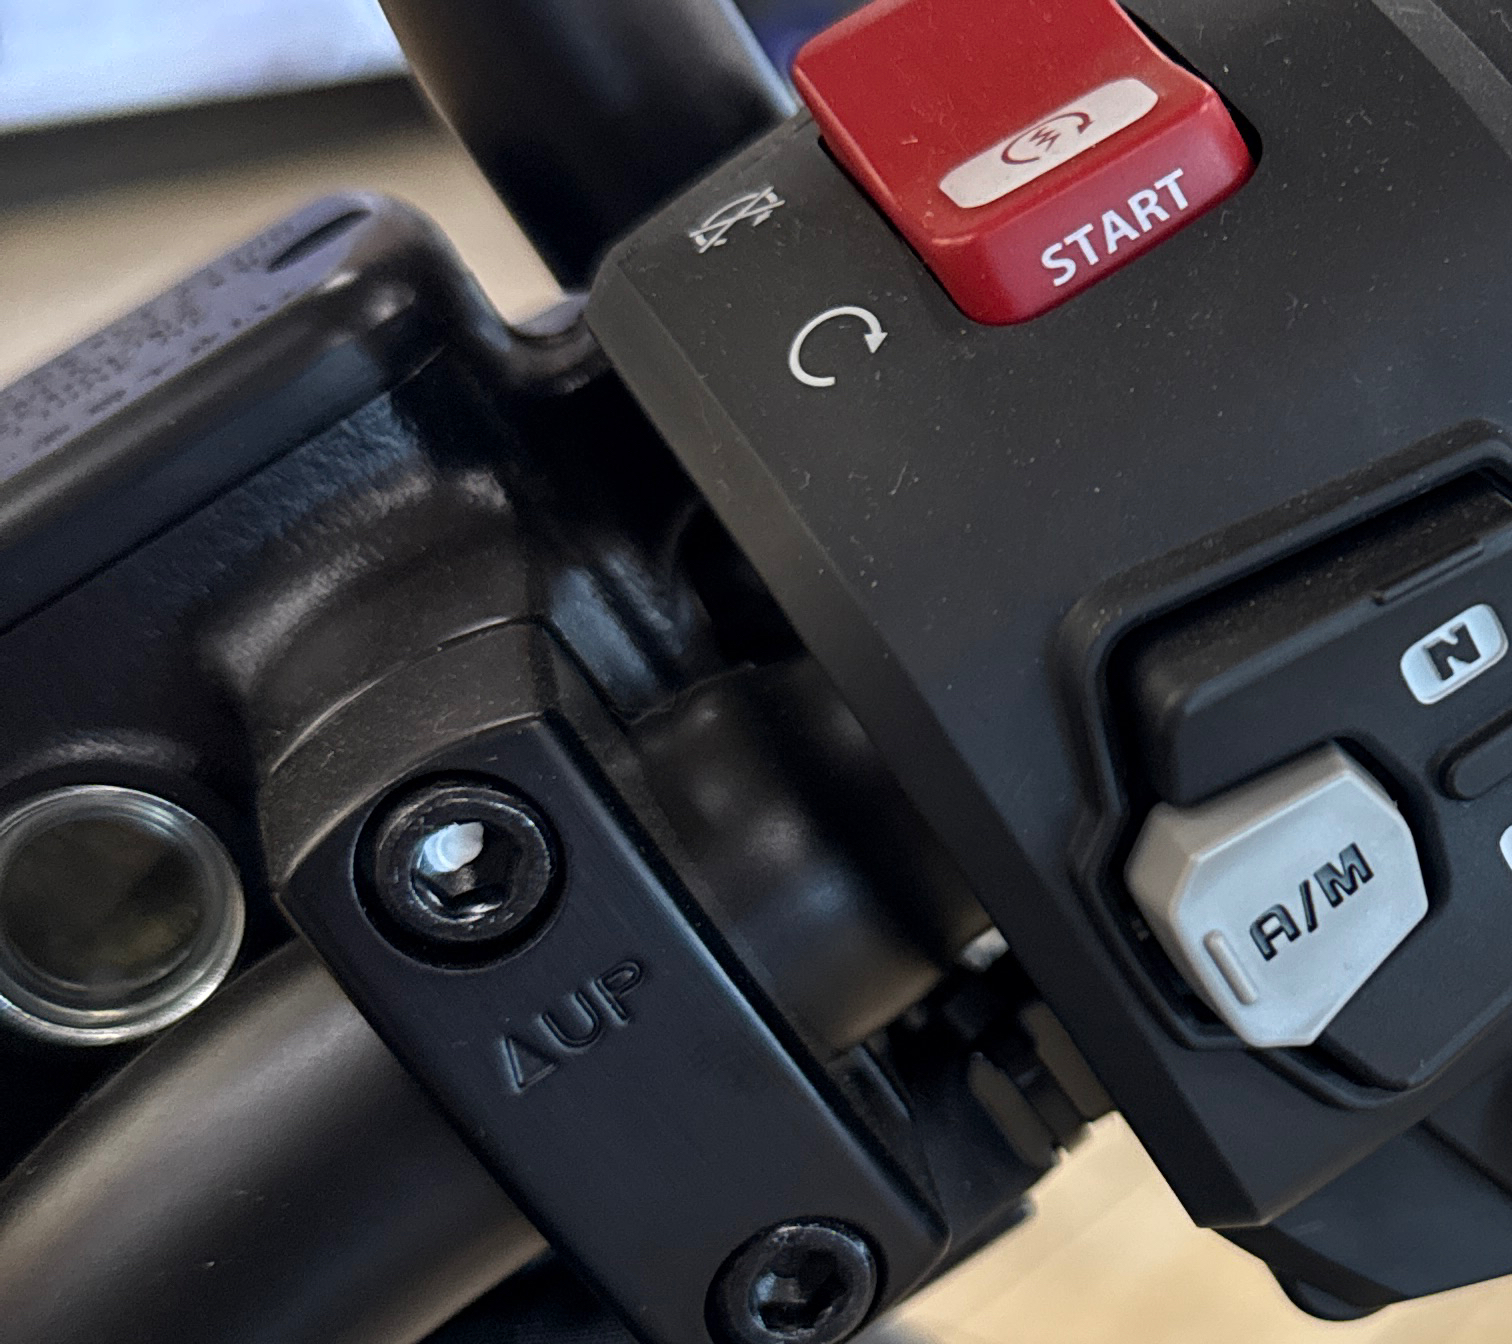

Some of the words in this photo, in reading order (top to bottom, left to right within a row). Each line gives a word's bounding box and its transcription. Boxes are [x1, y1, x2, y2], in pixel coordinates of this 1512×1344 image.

[1041, 167, 1189, 287] START
[1423, 622, 1482, 682] N
[1247, 841, 1377, 963] A/M
[534, 959, 645, 1056] UP
